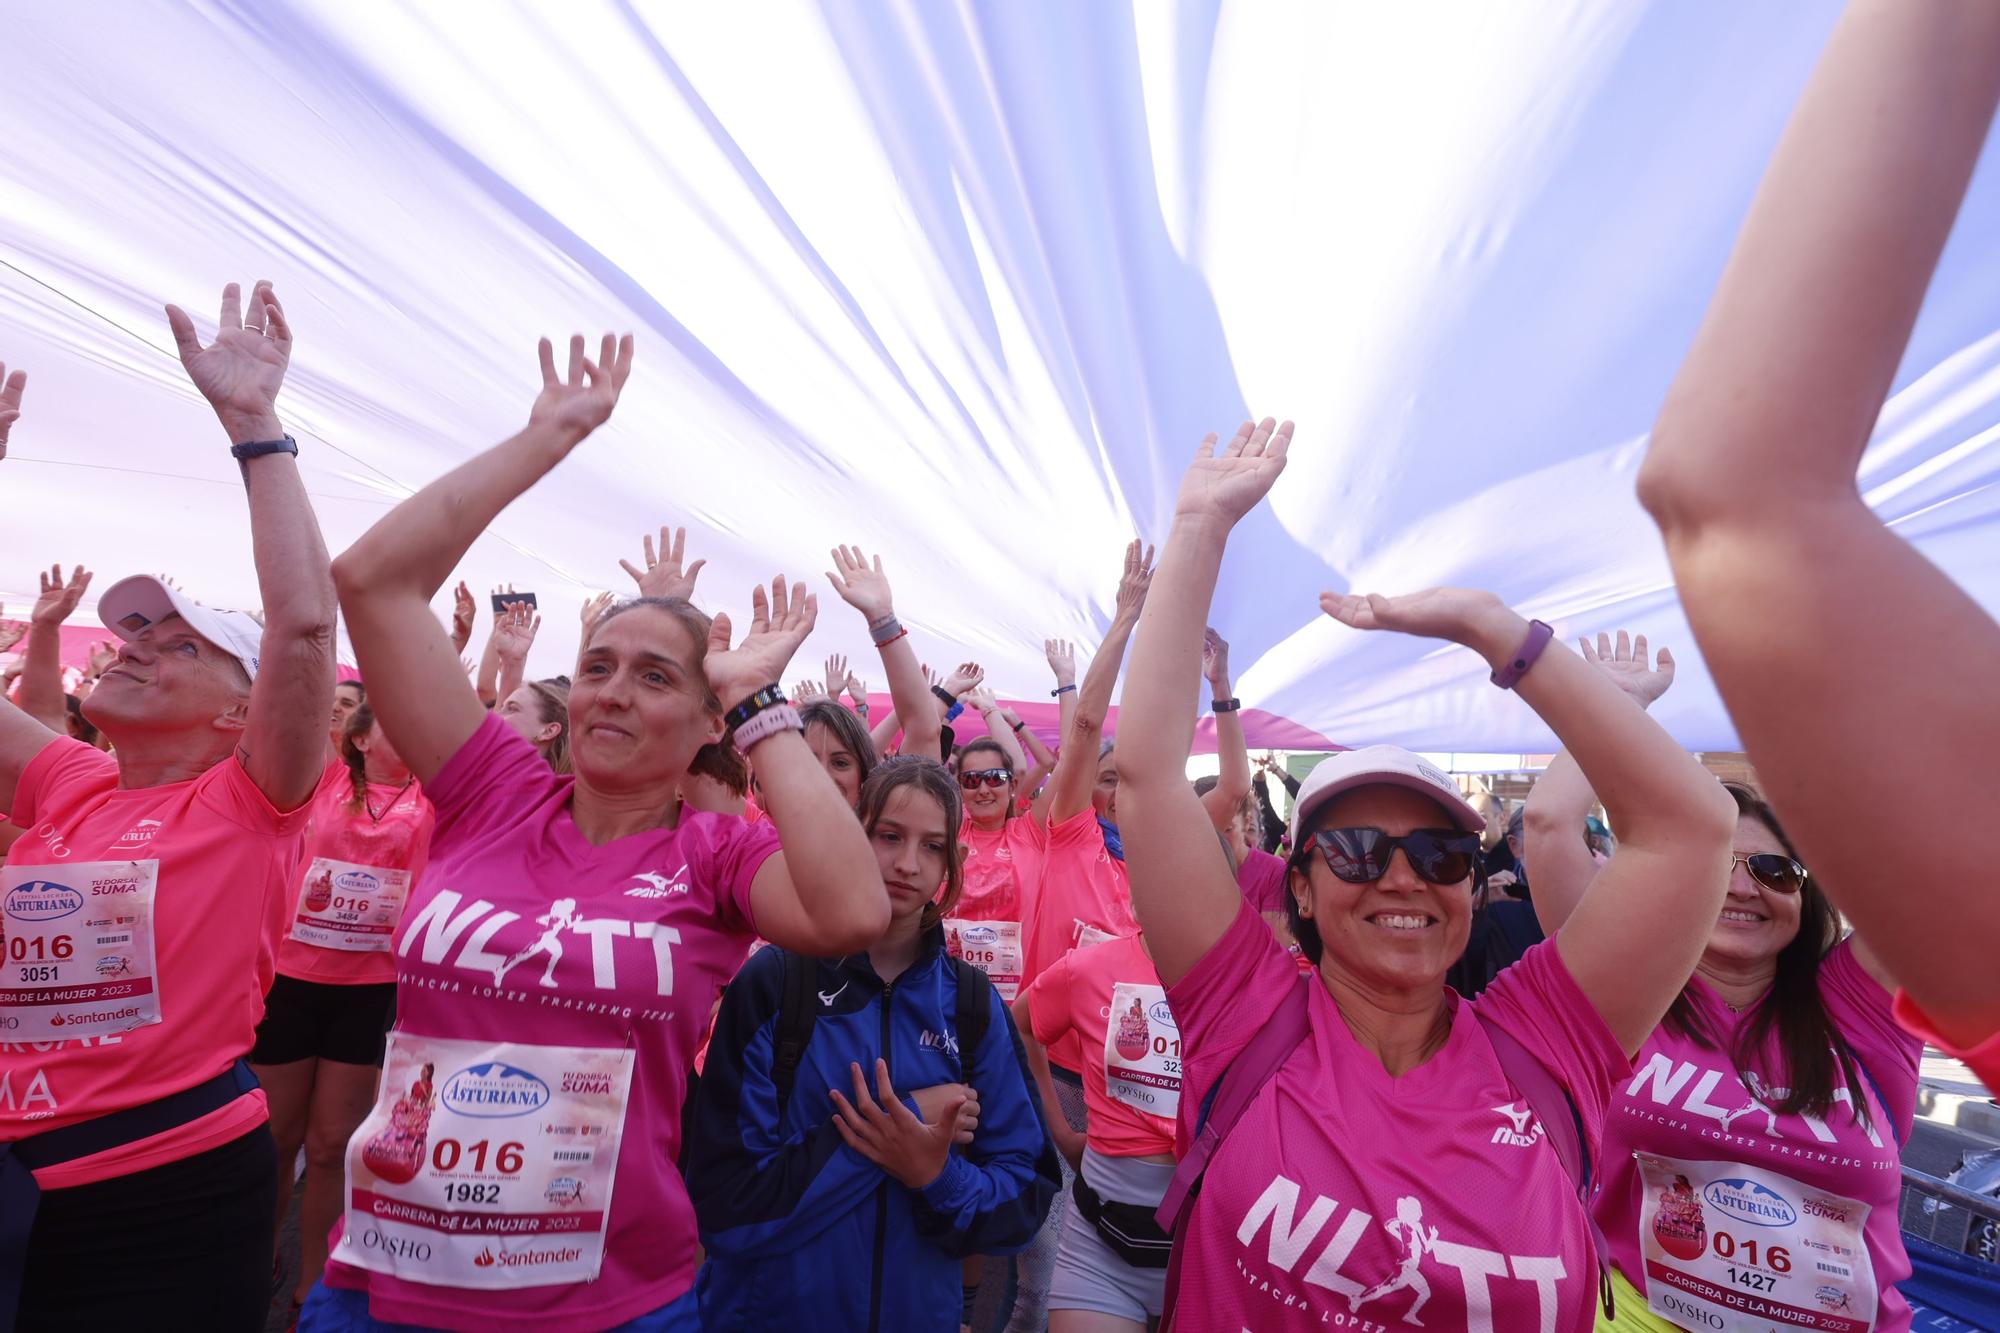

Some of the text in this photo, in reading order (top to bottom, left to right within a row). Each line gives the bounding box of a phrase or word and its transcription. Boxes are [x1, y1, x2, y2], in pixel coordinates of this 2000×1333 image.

[92, 884, 137, 896] SUMA
[333, 896, 370, 912] 016
[11, 935, 74, 961] 016
[965, 950, 994, 962] 016
[20, 966, 59, 982] 3051
[20, 993, 33, 1002] DE
[37, 992, 50, 1001] LA
[54, 989, 97, 1000] MUJER
[102, 985, 132, 996] 2023
[472, 985, 527, 1003] LOPEZ
[540, 995, 632, 1018] TRAINING
[67, 1007, 140, 1026] Santander
[560, 1081, 610, 1094] SUMA
[563, 1072, 612, 1081] TU DORSAL
[1120, 1071, 1180, 1088] CARRERA DE LA
[447, 1079, 539, 1105] ASTURIANA
[1117, 1085, 1155, 1104] OYSHO
[1623, 1105, 1688, 1131] NATACHA
[1701, 1128, 1756, 1147] LOPEZ
[1769, 1144, 1861, 1168] TRAINING
[432, 1138, 525, 1174] 016
[444, 1182, 500, 1204] 1982
[1711, 1187, 1790, 1221] ASTURIANA
[373, 1200, 581, 1231] CARRERA DE LA MUJER 2023
[1803, 1204, 1846, 1223] SUMA
[362, 1229, 582, 1268] OYSHO Santander
[1713, 1231, 1792, 1273] 016
[1727, 1268, 1777, 1293] 1427
[1236, 1258, 1386, 1333] NATACHA LOPEZ
[1665, 1272, 1850, 1332] CARRERA DE LA MUJER 2023
[1663, 1294, 1724, 1330] OYSHO
